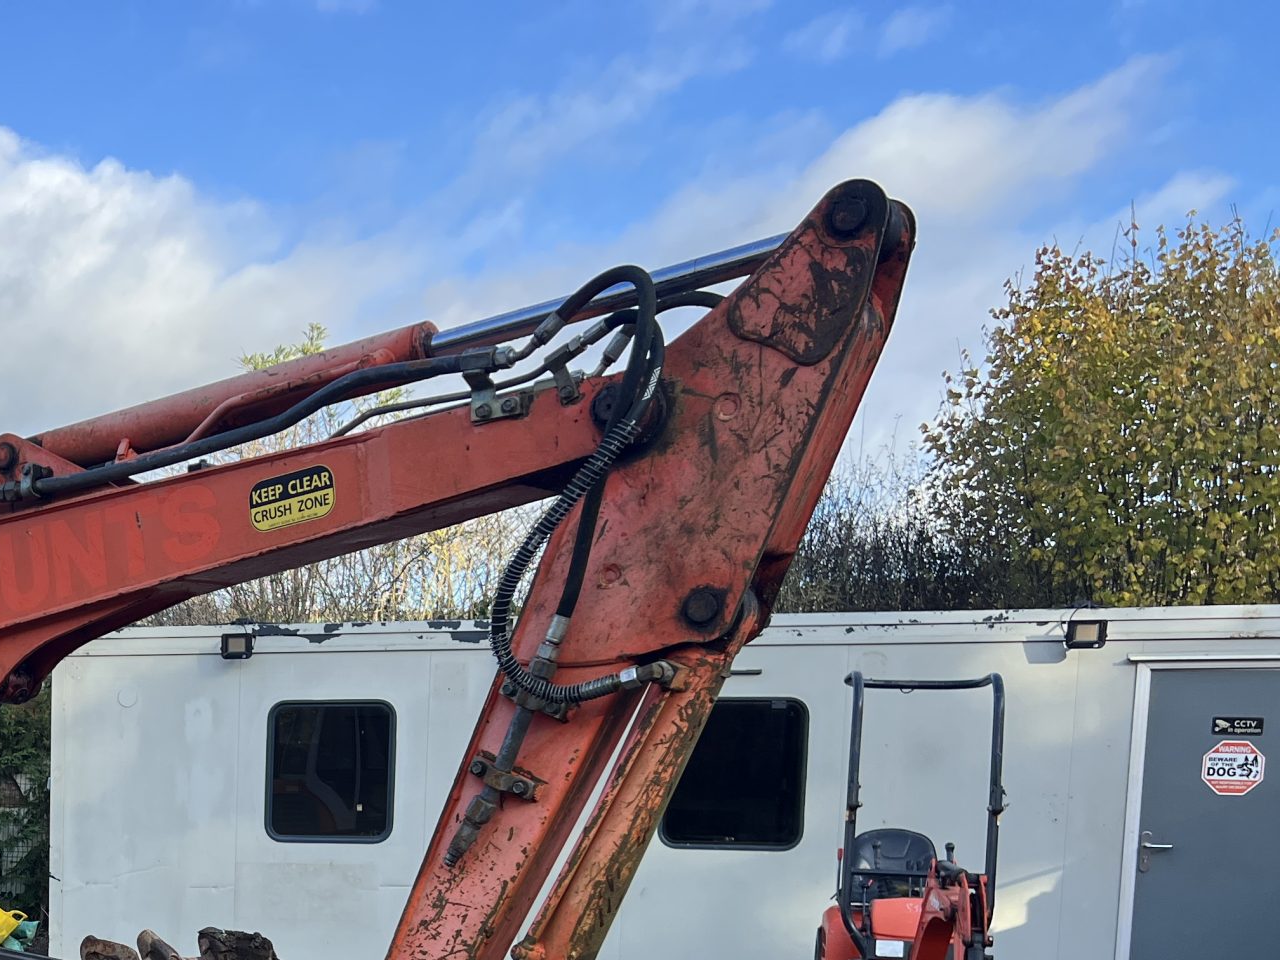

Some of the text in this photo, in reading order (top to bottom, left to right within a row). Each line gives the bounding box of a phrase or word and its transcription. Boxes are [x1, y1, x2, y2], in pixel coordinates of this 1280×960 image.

[252, 471, 330, 505] KEEP CLEAR
[253, 503, 292, 523] CRUSH
[298, 493, 330, 512] ZONE
[1234, 720, 1257, 728] CCTV
[1218, 746, 1252, 754] WARNING
[1206, 766, 1237, 777] DOG
